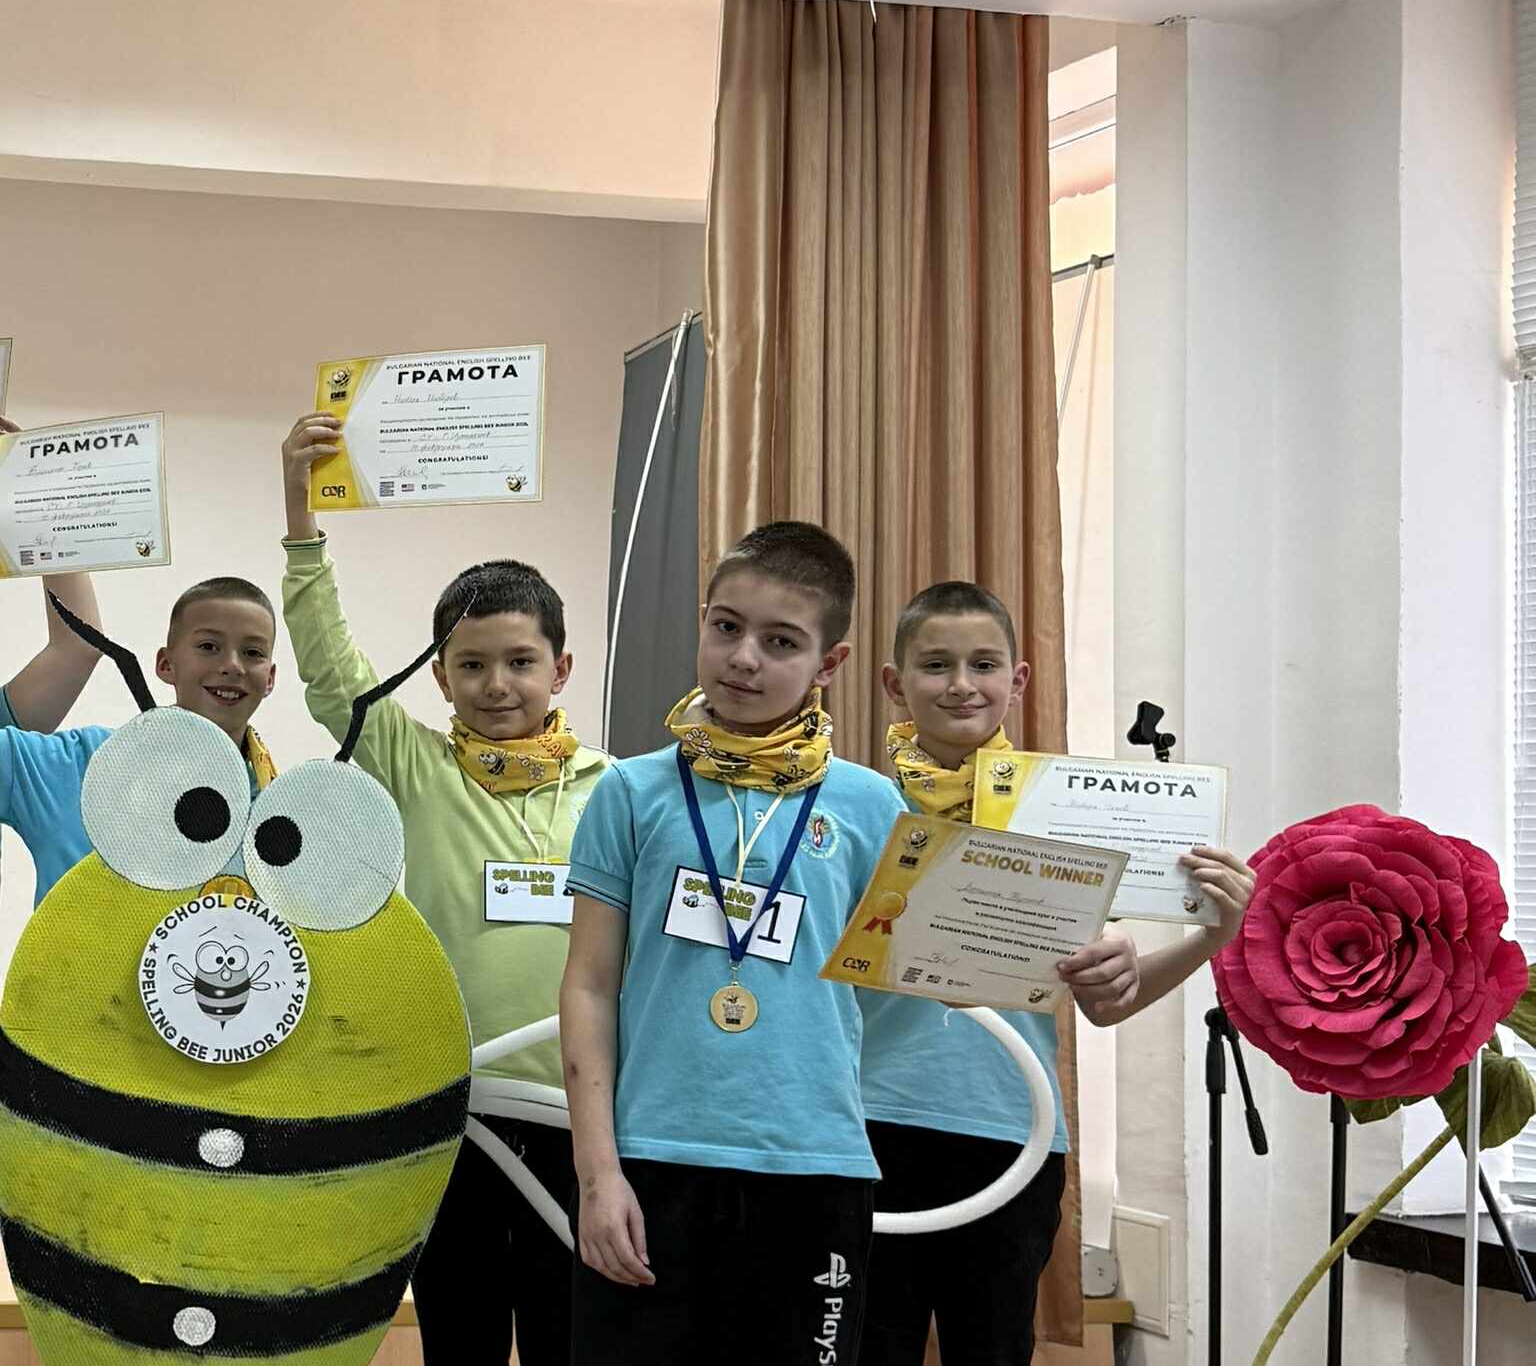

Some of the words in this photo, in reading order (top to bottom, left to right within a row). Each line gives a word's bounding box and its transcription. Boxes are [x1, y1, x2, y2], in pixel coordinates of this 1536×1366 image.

[397, 364, 519, 385] ГРАМОТА
[29, 433, 140, 459] ГРАМОТА
[1067, 775, 1198, 798] ГРАМОТА
[961, 849, 1033, 875] SCHOOL
[1039, 862, 1105, 887] WINNER
[155, 895, 227, 940] SCHOOL
[233, 896, 307, 974] CHAMPION
[757, 900, 781, 944] 1
[142, 957, 177, 1040] SPELLING
[177, 1036, 209, 1060] BEE
[212, 1033, 278, 1063] JUNIOR
[276, 993, 304, 1036] 2026
